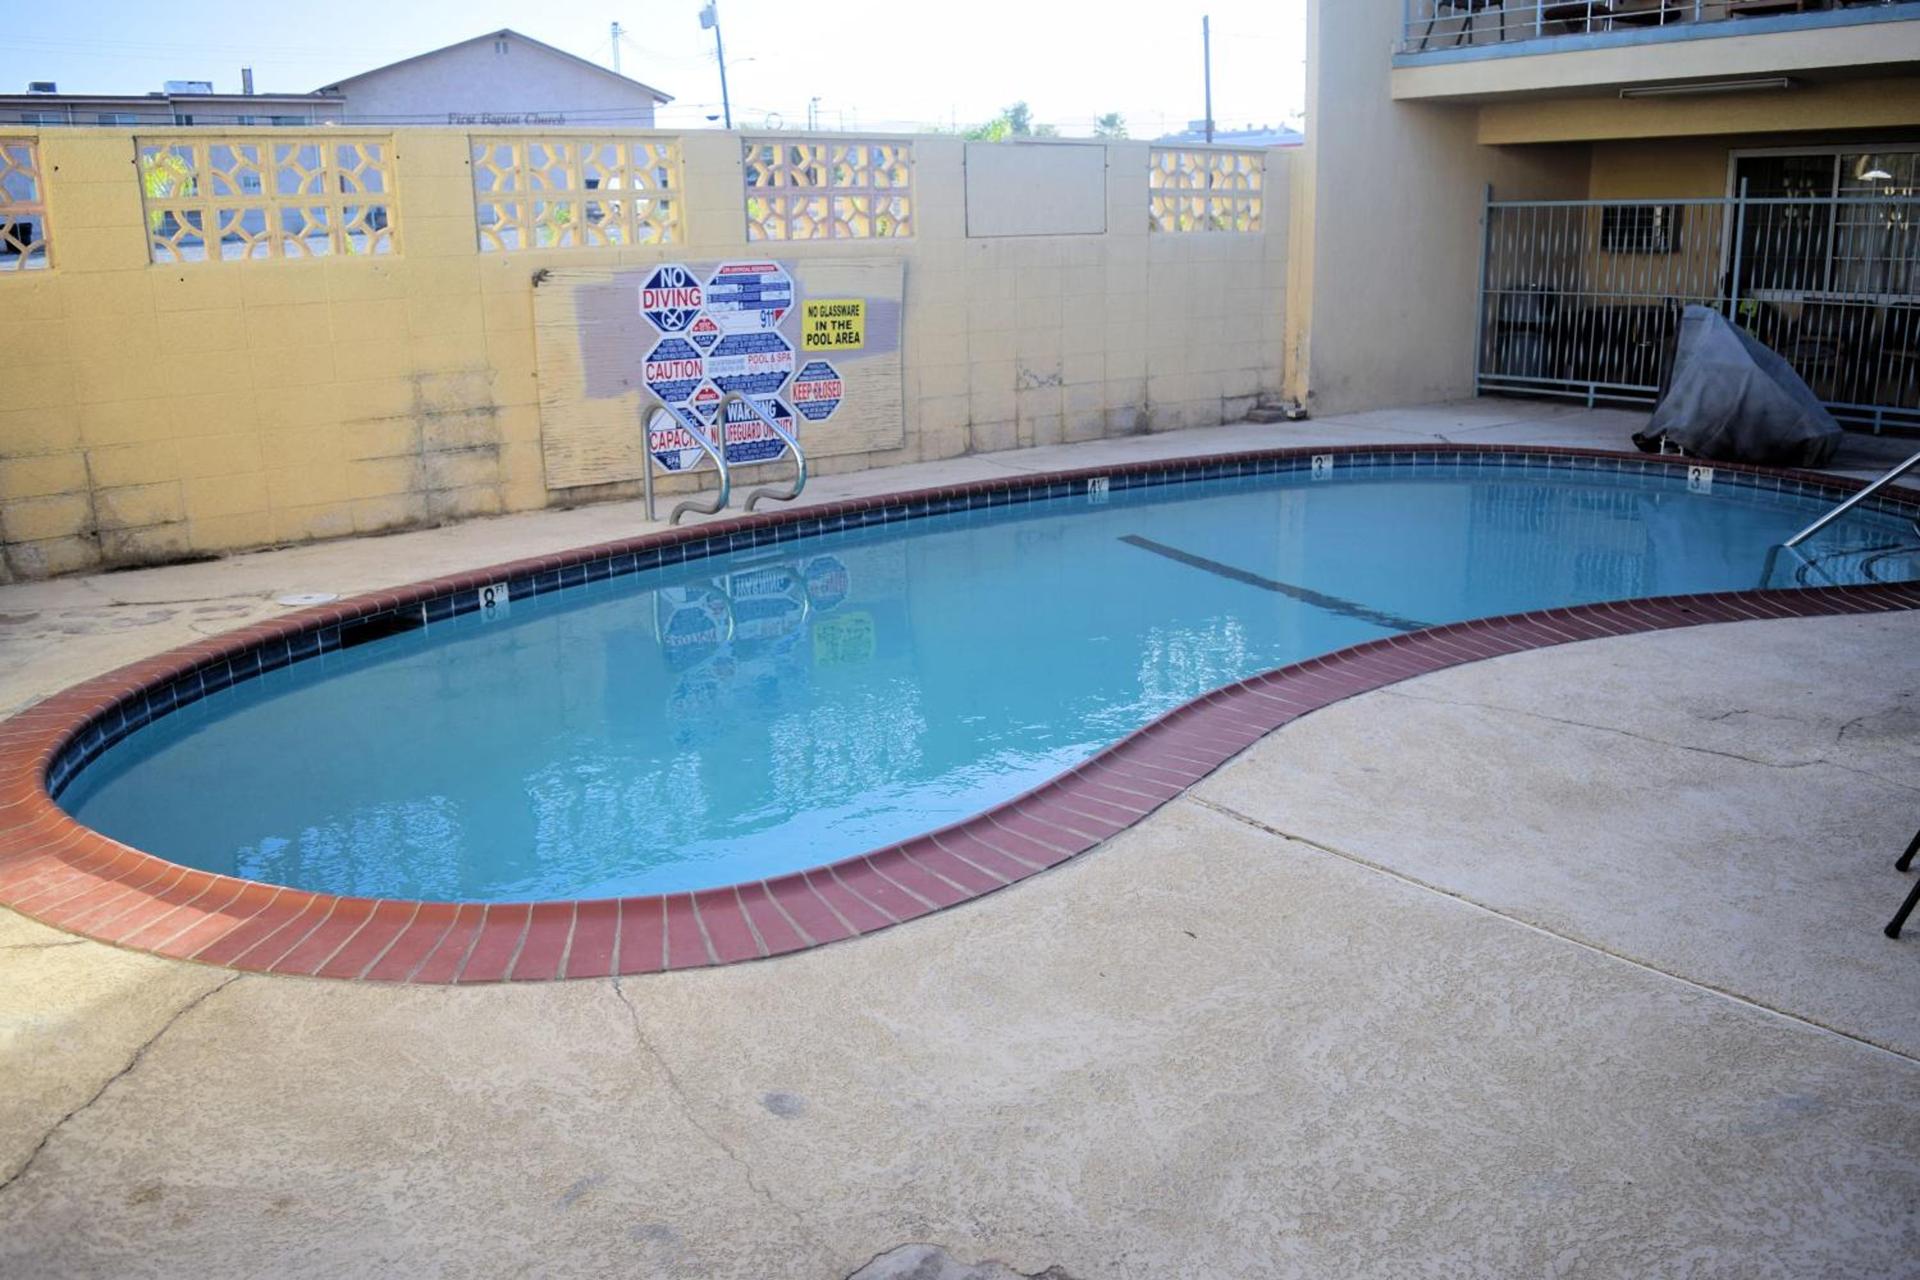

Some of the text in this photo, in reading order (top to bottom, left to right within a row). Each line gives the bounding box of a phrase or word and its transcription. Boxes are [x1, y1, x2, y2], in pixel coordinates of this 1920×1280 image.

[447, 112, 477, 125] First
[480, 112, 521, 126] Baptist
[660, 267, 686, 288] NO
[643, 288, 702, 309] DIVING
[760, 309, 775, 329] 911
[808, 304, 860, 318] NO GLASSWARE
[815, 319, 853, 332] IN THE
[806, 331, 861, 346] POOL AREA
[748, 354, 769, 365] POOL
[776, 352, 792, 362] SPA
[645, 359, 703, 381] CAUTION
[792, 382, 812, 401] KEEP
[813, 381, 842, 399] CLOSED
[727, 400, 777, 424] WARNG
[650, 425, 706, 451] CAPAC
[725, 421, 761, 443] IFEGUARD
